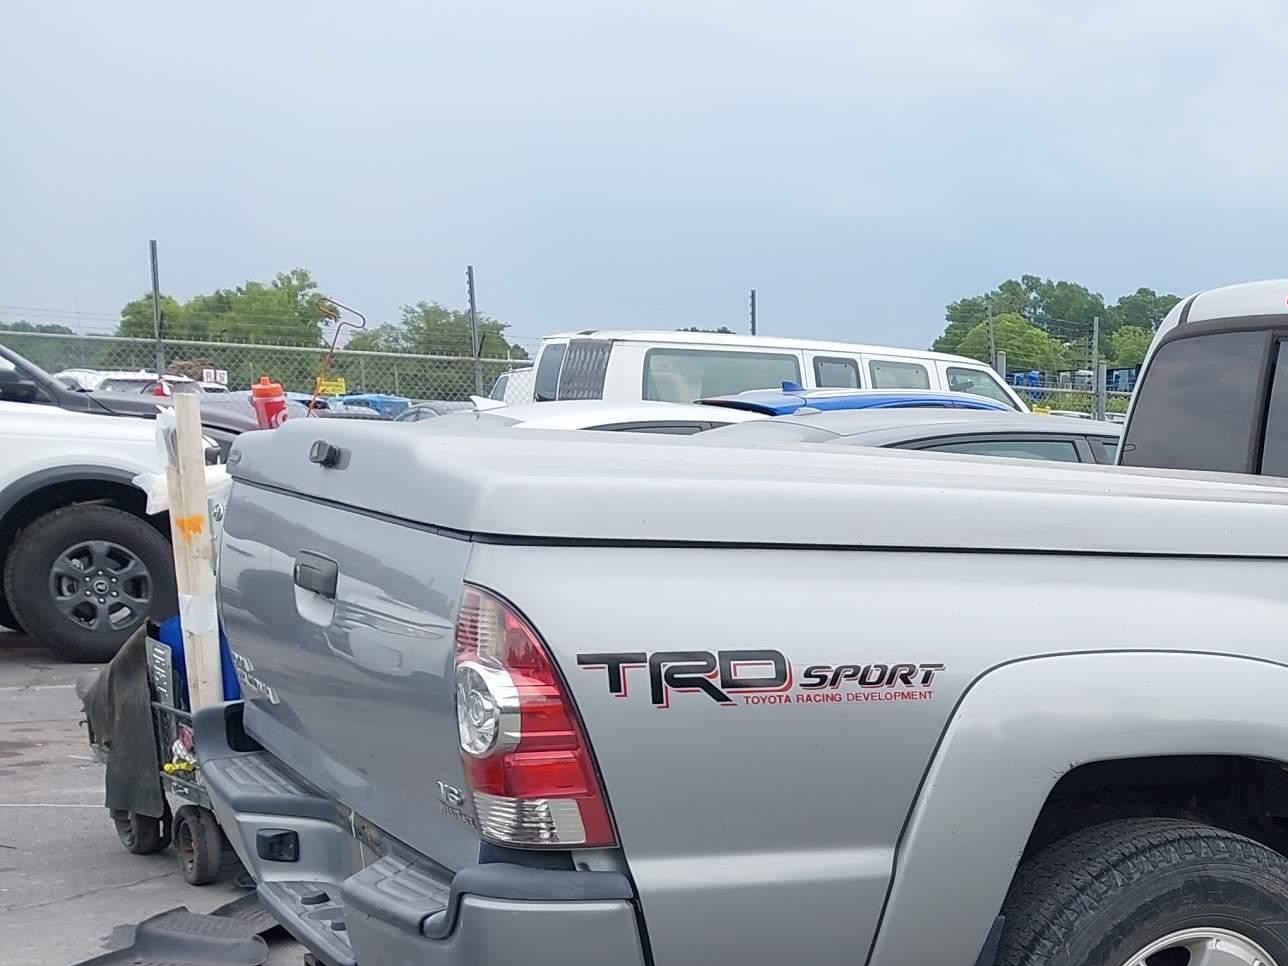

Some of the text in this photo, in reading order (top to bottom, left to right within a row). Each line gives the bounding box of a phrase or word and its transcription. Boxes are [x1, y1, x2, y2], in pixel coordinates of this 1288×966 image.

[577, 649, 945, 708] TRD SPORT
[744, 690, 934, 705] TOYOTA RACING DEVELOPMENT
